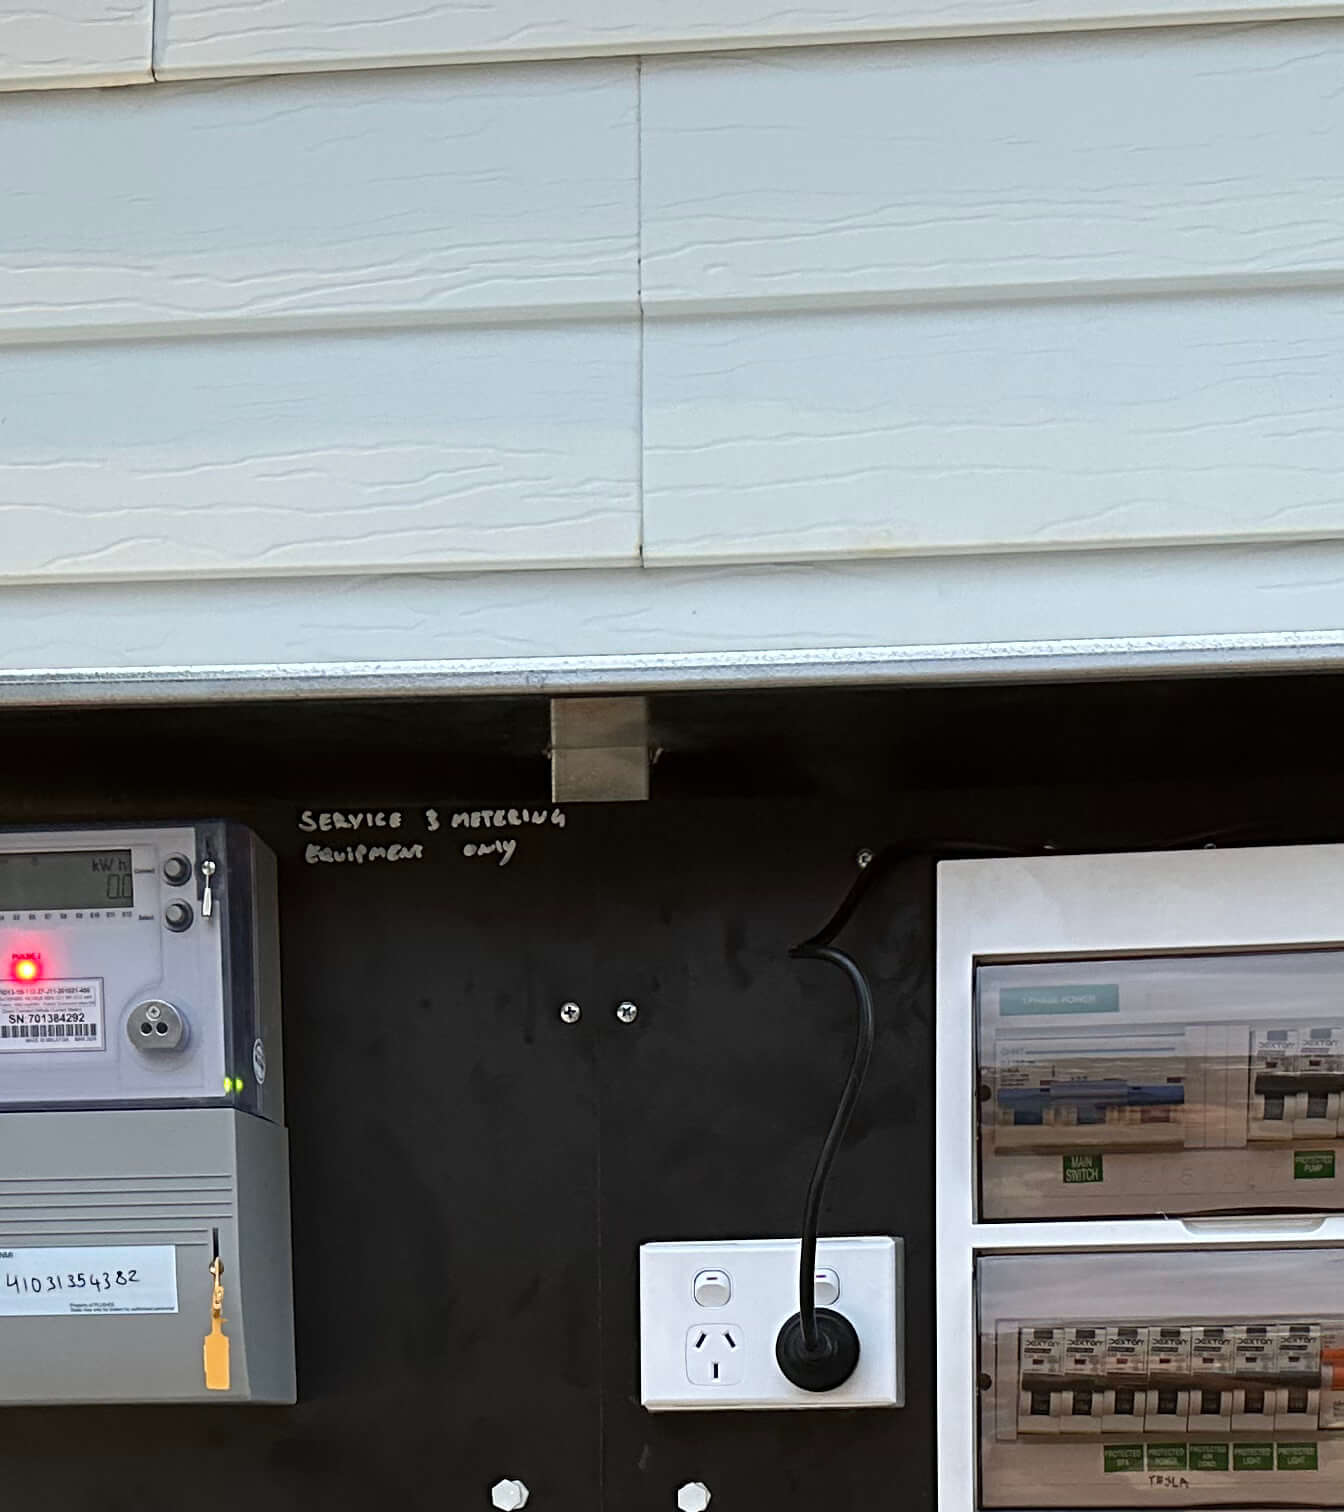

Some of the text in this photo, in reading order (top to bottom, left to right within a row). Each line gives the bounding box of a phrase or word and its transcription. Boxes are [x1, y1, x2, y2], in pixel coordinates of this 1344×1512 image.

[298, 810, 402, 832] SERVICE
[451, 808, 566, 828] METERING
[305, 843, 423, 864] EQUIPMENT
[9, 1014, 24, 1024] SN
[1071, 1155, 1092, 1167] MAIN
[1066, 1167, 1099, 1182] SWITCH
